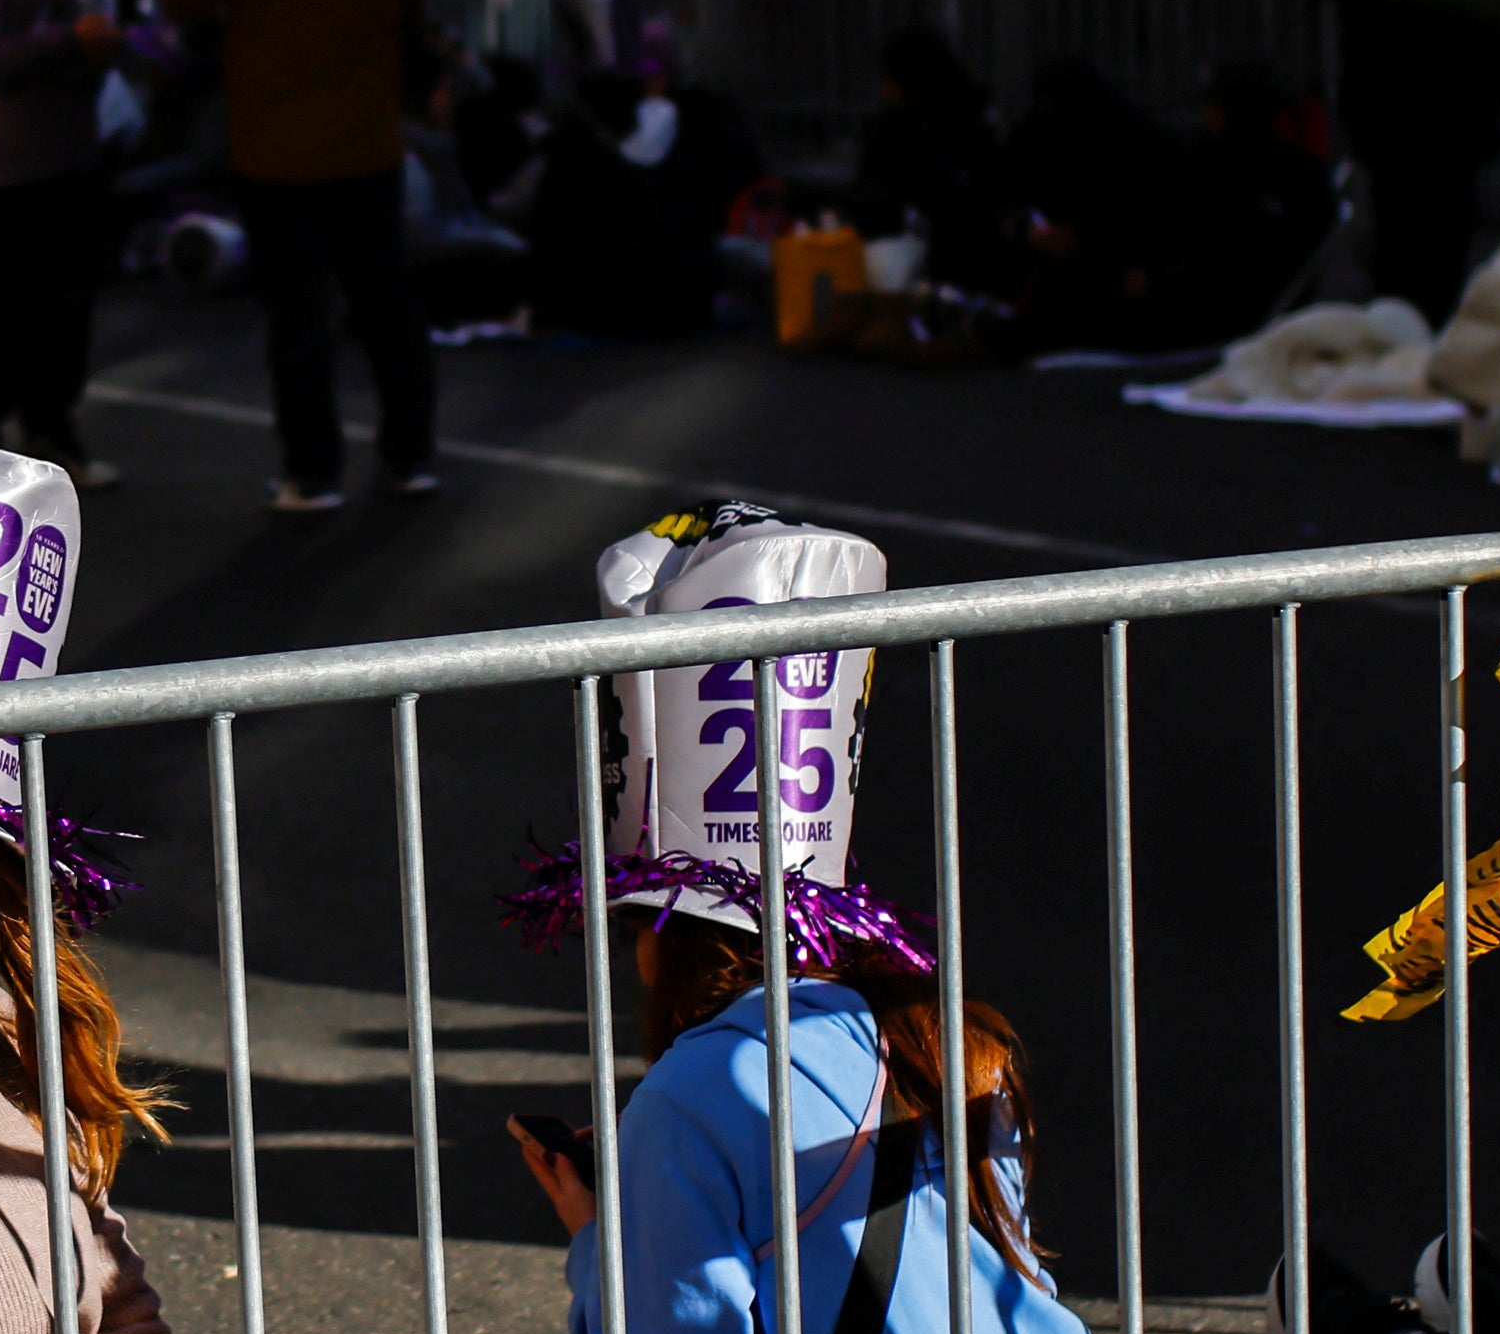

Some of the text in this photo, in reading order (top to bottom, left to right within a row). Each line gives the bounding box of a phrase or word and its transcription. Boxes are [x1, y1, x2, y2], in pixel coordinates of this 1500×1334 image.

[31, 542, 63, 579] NEW
[28, 565, 59, 596] YEAR'S
[22, 583, 56, 625] EVE
[786, 658, 828, 688] EVE
[699, 708, 835, 813] 25
[704, 819, 832, 846] TIMES QUARE
